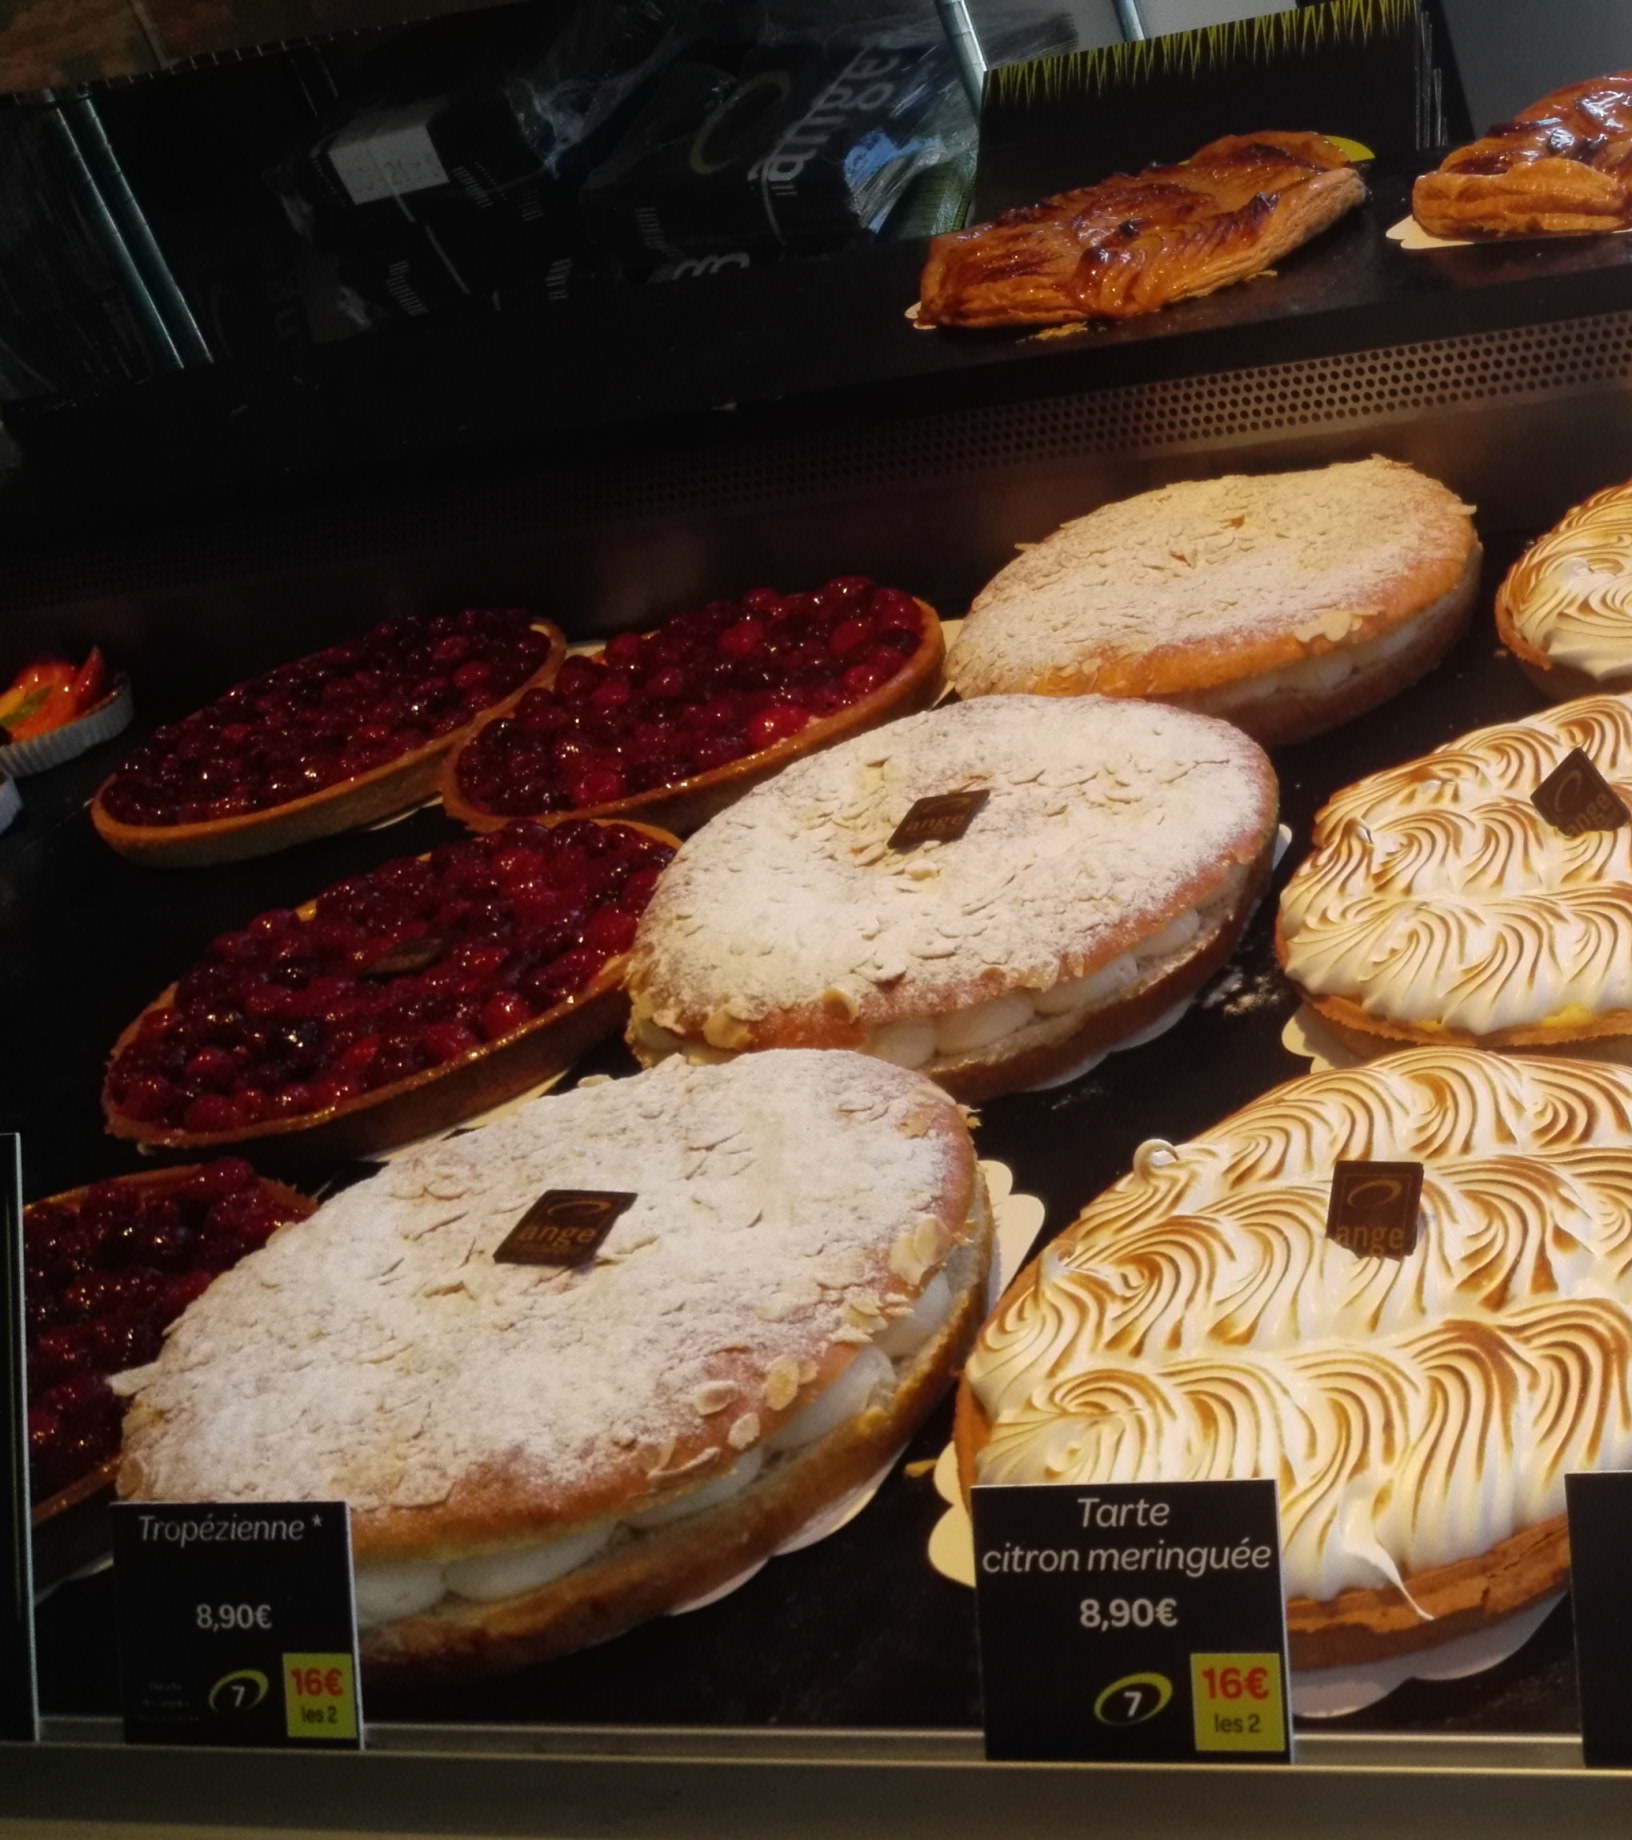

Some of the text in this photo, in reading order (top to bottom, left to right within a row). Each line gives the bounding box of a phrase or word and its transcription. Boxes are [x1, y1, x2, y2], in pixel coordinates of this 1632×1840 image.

[518, 1225, 598, 1248] ange
[1335, 1225, 1405, 1257] ange
[1078, 1498, 1170, 1527] Tarte
[983, 1537, 1271, 1577] citron meringuée
[197, 1604, 271, 1631] 8,90€
[1080, 1598, 1177, 1631] 8,90€
[291, 1668, 342, 1696] 16€
[1201, 1668, 1268, 1700] 16€
[232, 1686, 245, 1706] 7
[1125, 1692, 1142, 1716] 7
[302, 1706, 338, 1724] les 2
[1214, 1713, 1261, 1734] les 2
